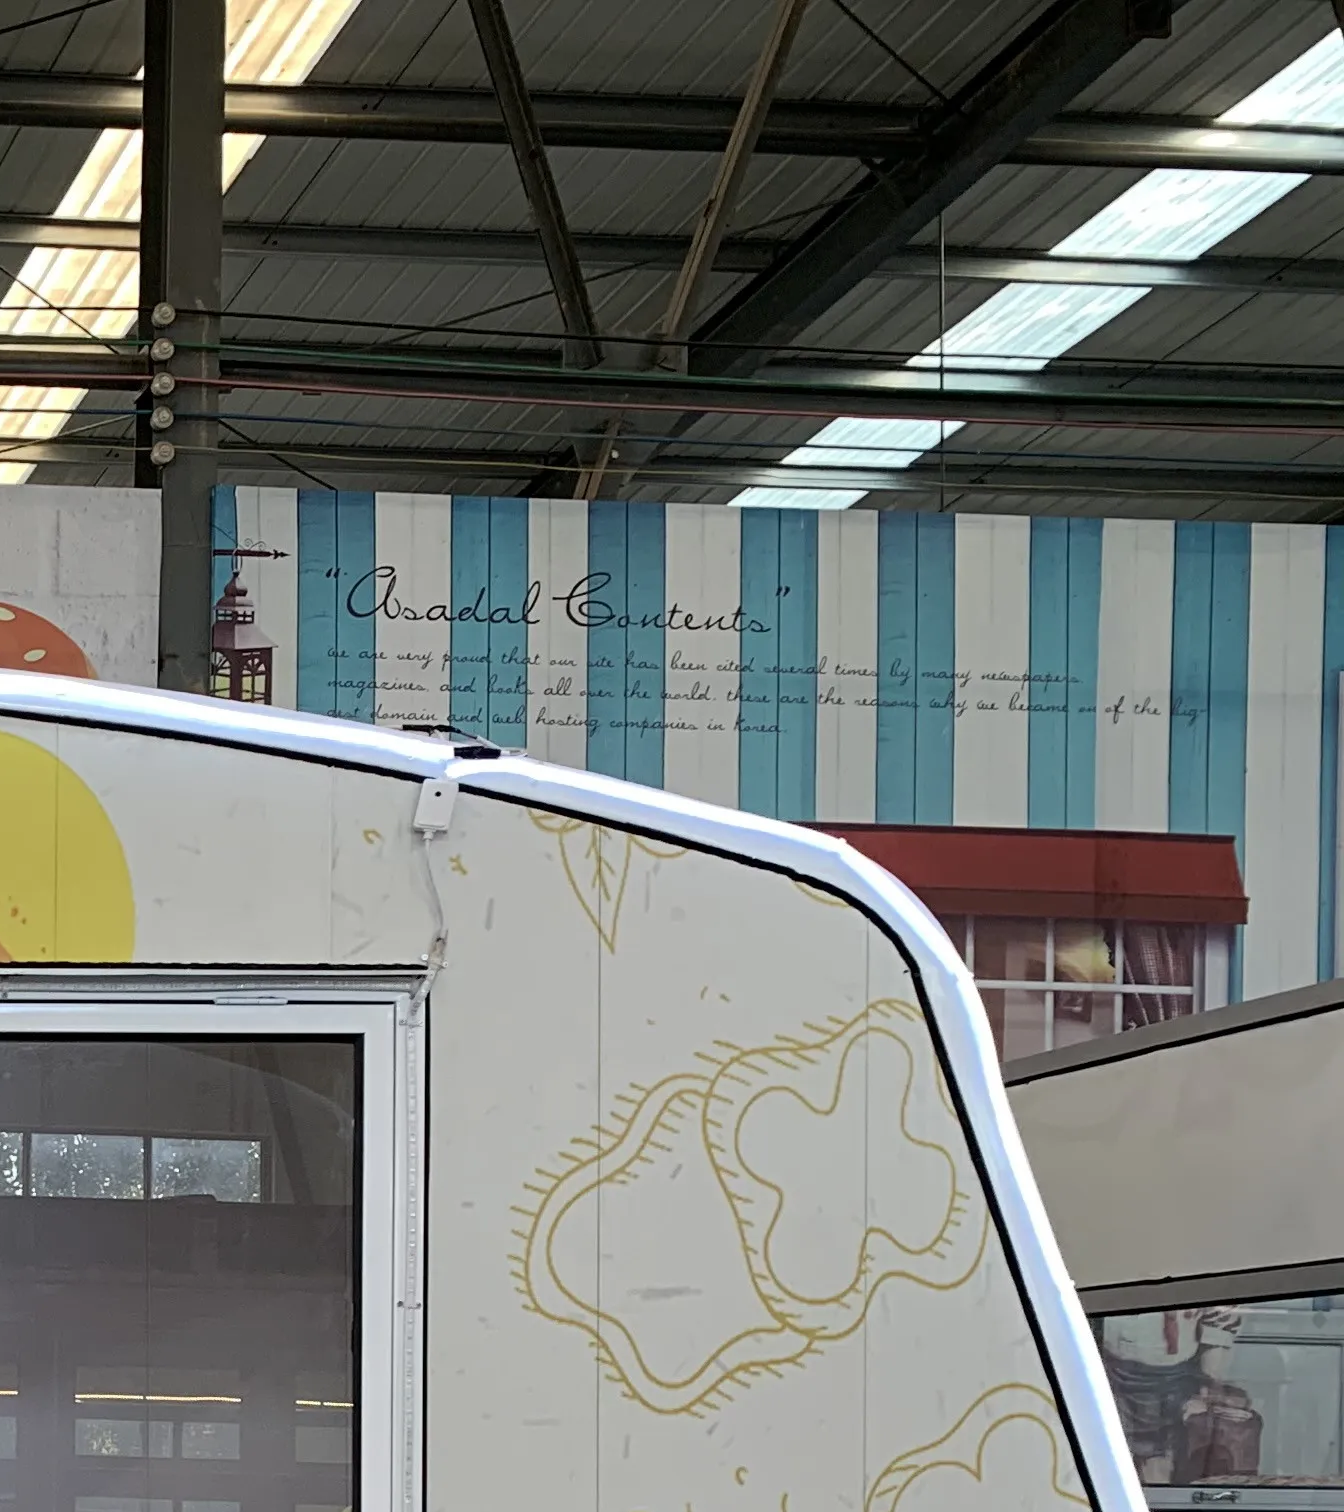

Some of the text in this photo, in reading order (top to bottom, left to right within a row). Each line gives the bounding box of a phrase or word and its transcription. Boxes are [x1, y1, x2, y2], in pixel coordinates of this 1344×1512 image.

[358, 650, 389, 660] are
[397, 651, 434, 670] very
[442, 648, 493, 671] proud
[501, 647, 541, 666] that
[549, 659, 578, 667] our
[587, 656, 615, 669] site
[625, 650, 661, 670] has
[670, 650, 708, 671] been
[716, 656, 755, 673] cited
[764, 655, 828, 676] several
[835, 663, 878, 678] times
[921, 670, 972, 688] many
[439, 677, 477, 693] and
[487, 674, 535, 696] books
[543, 676, 573, 697] all
[579, 690, 615, 698] over
[623, 679, 652, 699] the
[726, 684, 771, 704] these
[779, 696, 809, 705] are
[816, 687, 846, 707] the
[853, 697, 921, 709] reasons
[928, 692, 969, 718] why
[1008, 692, 1070, 713] became
[1104, 695, 1125, 724] of
[1133, 697, 1162, 716] the
[370, 704, 438, 721] domain
[446, 707, 483, 724] and
[491, 704, 527, 724] web
[535, 707, 600, 738] hosting
[609, 717, 699, 739] companies
[706, 717, 726, 731] in
